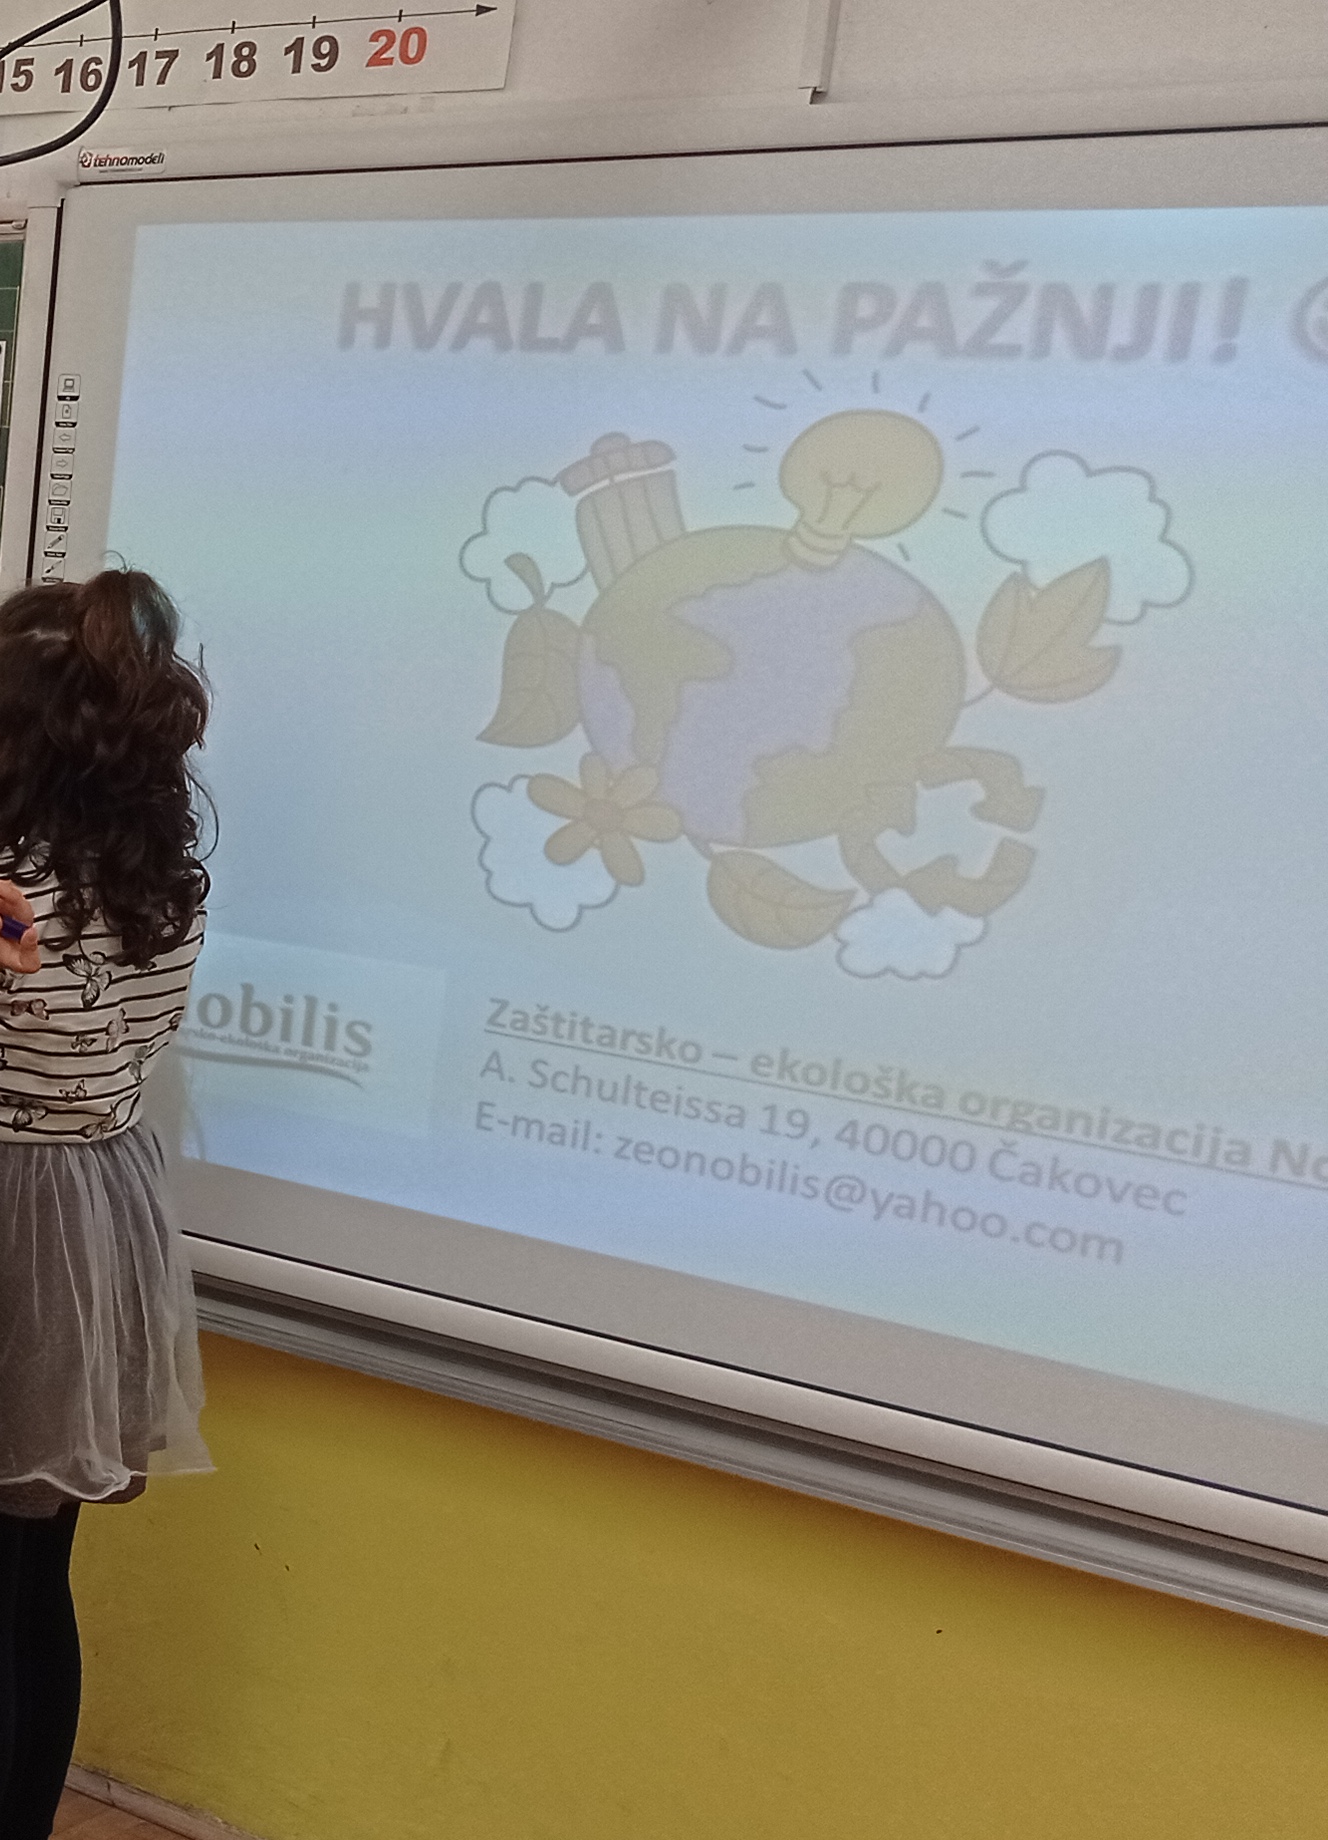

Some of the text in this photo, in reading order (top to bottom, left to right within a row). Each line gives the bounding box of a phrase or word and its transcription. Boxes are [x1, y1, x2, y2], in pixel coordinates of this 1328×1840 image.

[54, 56, 104, 94] 16
[128, 49, 180, 87] 17
[205, 40, 257, 80] 18
[284, 35, 340, 74] 19
[365, 26, 428, 68] 20
[338, 258, 1251, 365] HVALA NA PAŽNJI!
[196, 982, 373, 1058] obilis
[485, 998, 703, 1065] Zaštitarsko
[749, 1046, 945, 1111] ekološka
[957, 1088, 1252, 1170] organizacija
[475, 1100, 1125, 1265] E-mail: zeonobilis@yahoo.com
[480, 1049, 1189, 1217] A. Schulteissa 19, 40000 Čakovec
